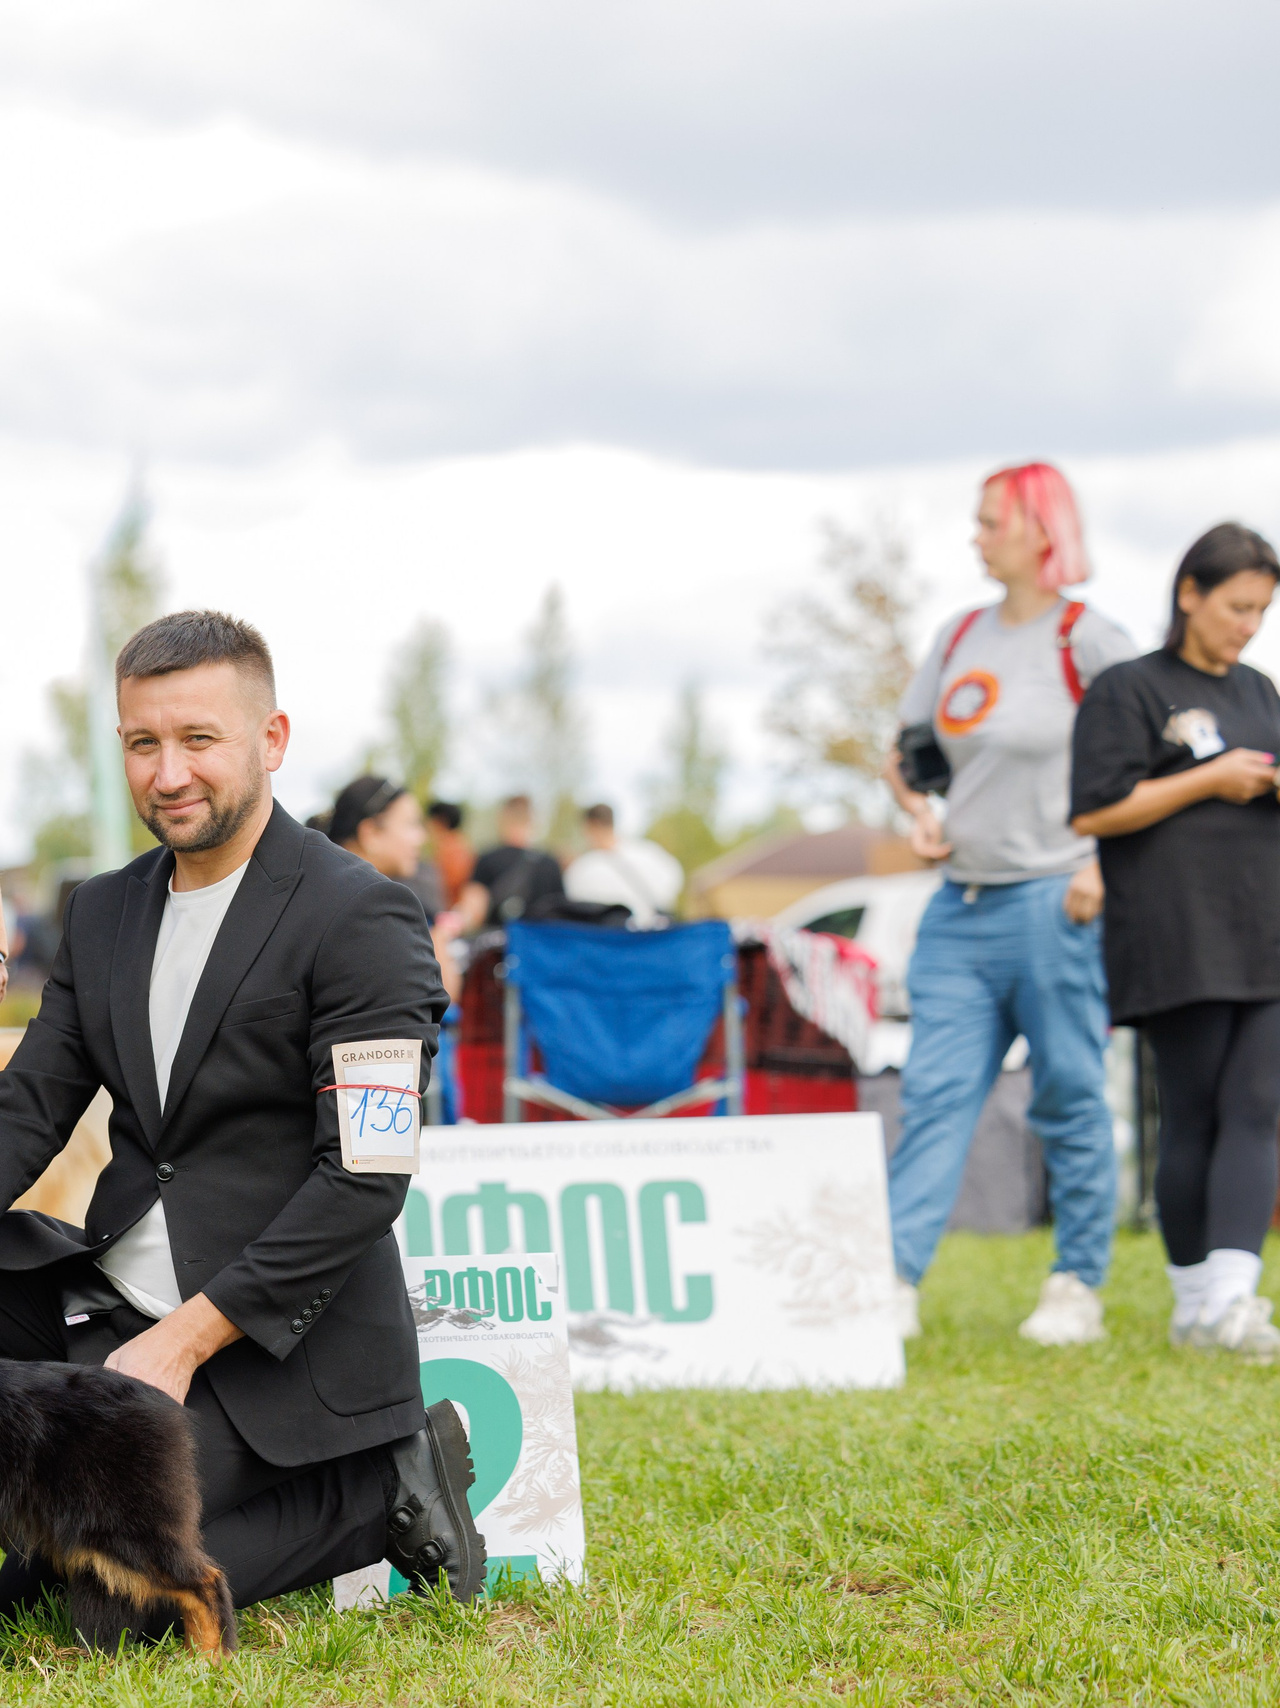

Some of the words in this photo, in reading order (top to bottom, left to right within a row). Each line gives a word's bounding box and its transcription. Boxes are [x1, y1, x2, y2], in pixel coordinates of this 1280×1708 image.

[341, 1049, 406, 1063] GRANDORF
[350, 1084, 413, 1138] 136
[424, 1265, 553, 1323] РФОС
[481, 1332, 555, 1342] СОБАКОВОДСТВА
